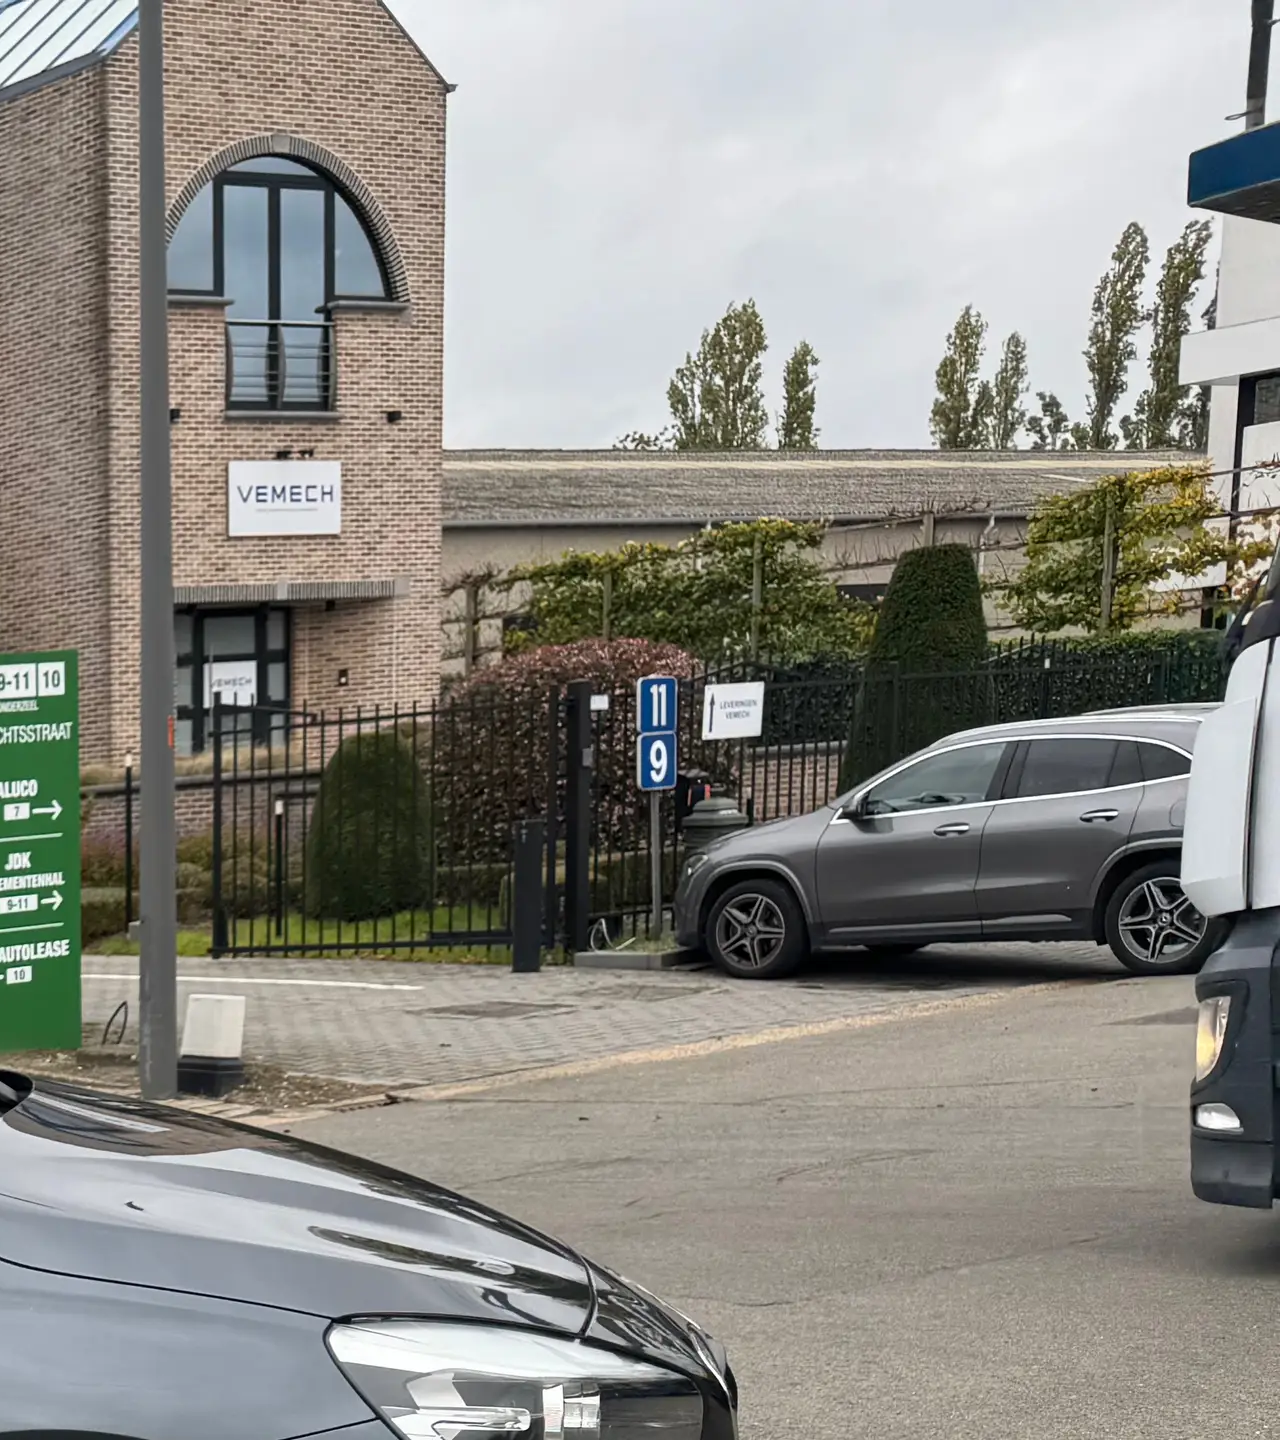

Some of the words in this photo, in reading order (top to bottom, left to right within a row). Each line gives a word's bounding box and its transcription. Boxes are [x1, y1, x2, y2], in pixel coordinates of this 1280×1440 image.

[236, 484, 333, 503] VEMECH
[42, 669, 61, 689] 10
[649, 683, 667, 727] 11
[649, 739, 668, 783] 9
[4, 852, 32, 871] JDK
[7, 898, 28, 910] 9-11
[13, 969, 25, 981] 10
